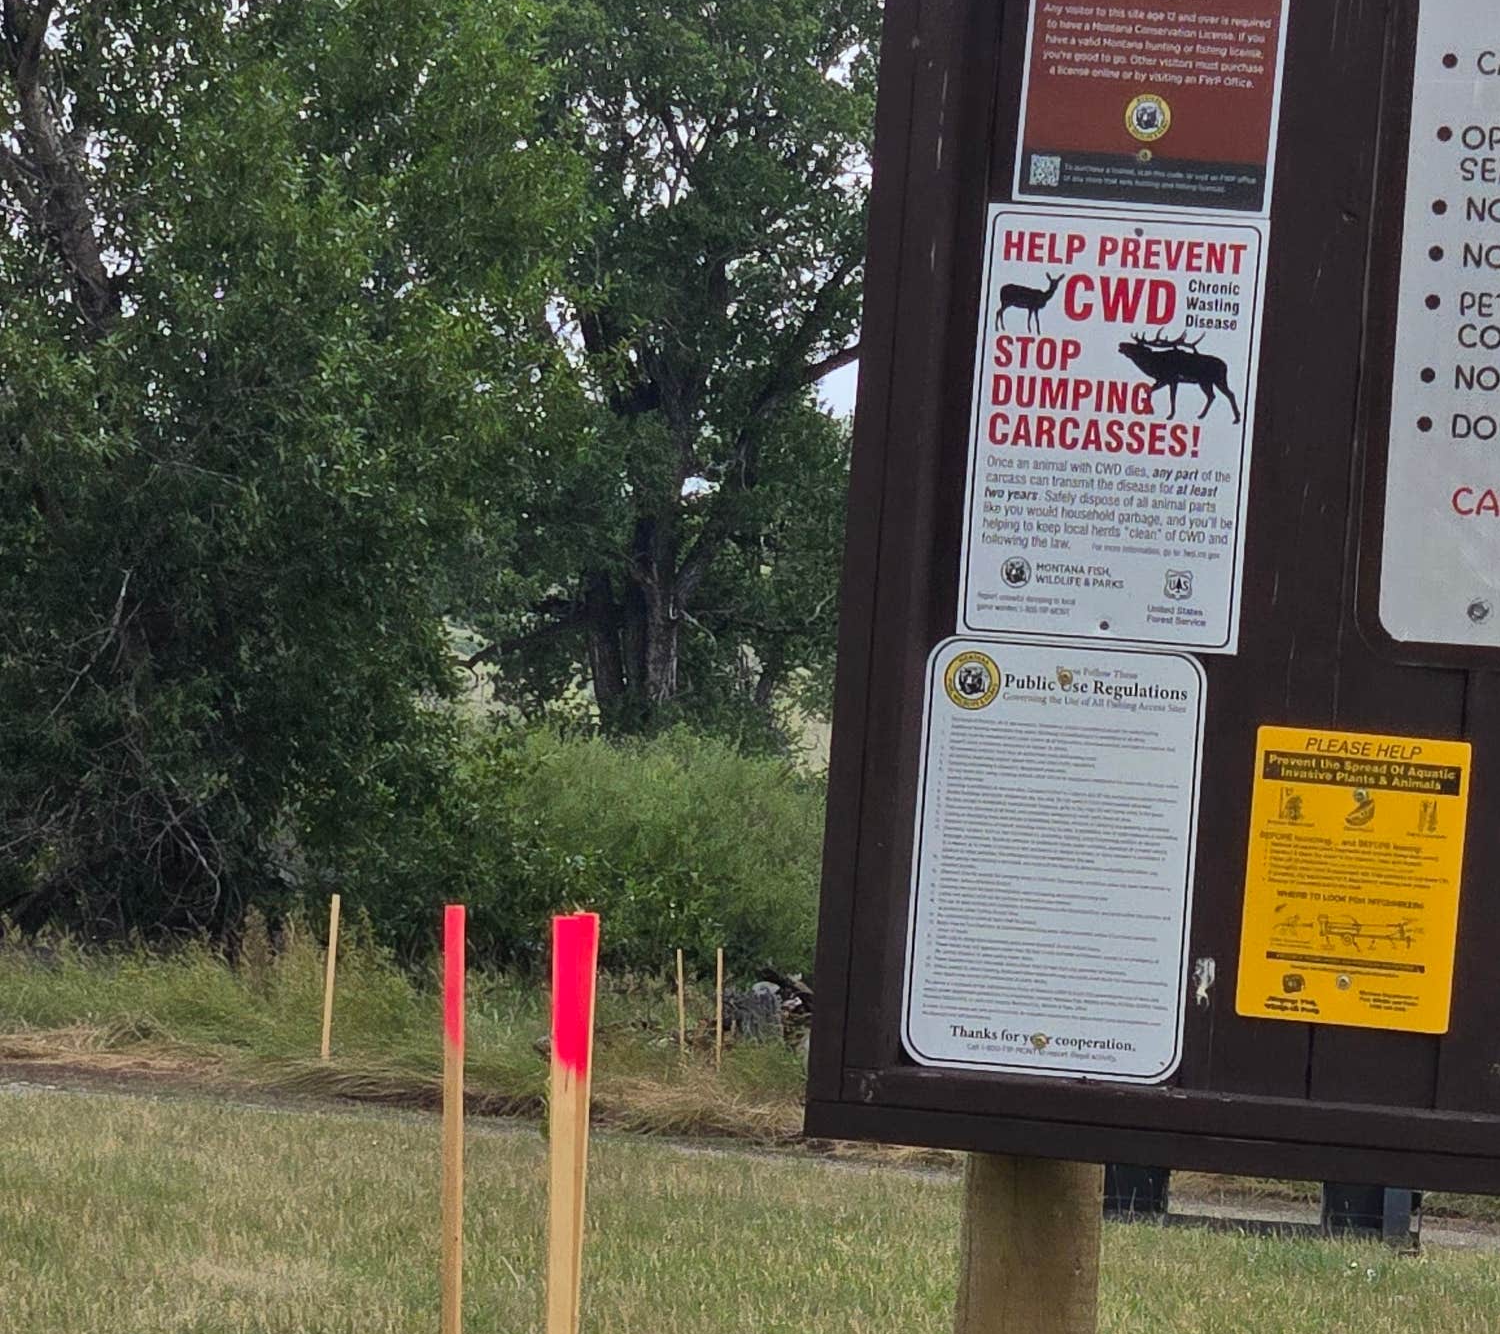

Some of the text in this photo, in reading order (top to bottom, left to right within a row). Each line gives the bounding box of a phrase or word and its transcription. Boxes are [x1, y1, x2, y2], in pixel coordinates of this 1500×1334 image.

[1003, 231, 1248, 275] HELP PREVENT
[1063, 274, 1177, 325] CWD
[1188, 279, 1240, 296] Chronic
[1186, 297, 1240, 315] Wasting
[1185, 314, 1238, 331] Disease
[993, 335, 1081, 371] STOP
[1454, 364, 1500, 392] NO
[991, 374, 1155, 415] DUMPING
[988, 412, 1201, 458] CARCASSES!
[1451, 413, 1497, 441] DO
[987, 455, 1013, 468] Once
[1017, 459, 1029, 469] an
[1033, 459, 1067, 472] animal
[1070, 461, 1092, 473] with
[1095, 462, 1122, 475] CWD
[1152, 467, 1173, 482] any
[1174, 468, 1198, 482] part
[1201, 470, 1212, 481] of
[1215, 470, 1231, 483] the
[985, 473, 1218, 498] carcass can transmit the disease for at least
[984, 486, 1217, 514] two years. Safely dispose of all animal parts
[1035, 575, 1082, 587] WILDLIFE
[1091, 578, 1125, 589] PARKS
[1036, 562, 1085, 575] MONTANA
[1004, 673, 1056, 692] Public
[1094, 681, 1188, 702] Regulations
[1305, 737, 1423, 760] PLEASE HELP
[1269, 754, 1316, 768] Prevent
[1321, 758, 1340, 770] the
[1344, 760, 1388, 776] Spread
[1408, 765, 1456, 781] Aquatic
[1281, 767, 1333, 781] Invasive
[1336, 772, 1375, 785] Plants
[1392, 777, 1441, 790] Animals
[950, 1025, 1136, 1052] Thanks for yr cooperation.
